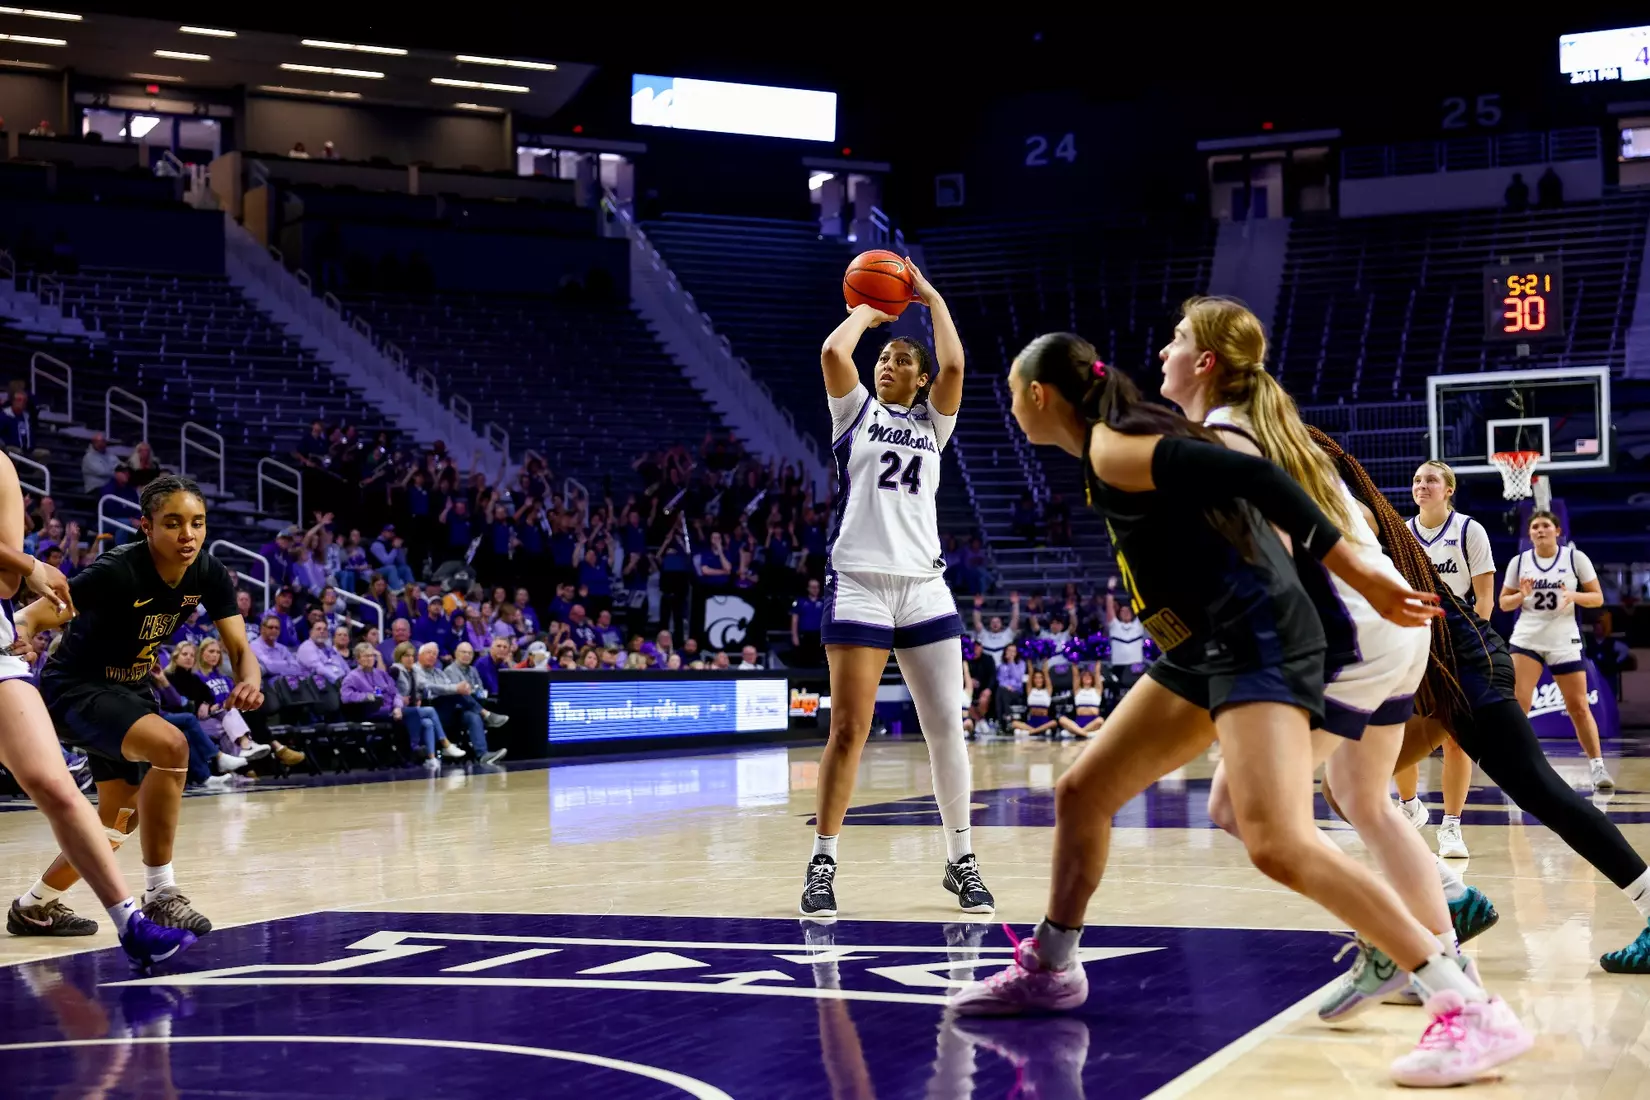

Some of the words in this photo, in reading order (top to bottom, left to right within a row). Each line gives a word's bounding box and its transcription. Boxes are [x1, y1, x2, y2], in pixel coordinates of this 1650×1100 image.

[1442, 94, 1502, 128] 25
[1025, 132, 1077, 166] 24
[1506, 273, 1551, 296] 5:21
[1503, 295, 1546, 333] 30
[868, 423, 936, 454] Wildcats
[877, 450, 923, 495] 24
[1533, 591, 1557, 611] 23
[138, 612, 181, 641] WEST
